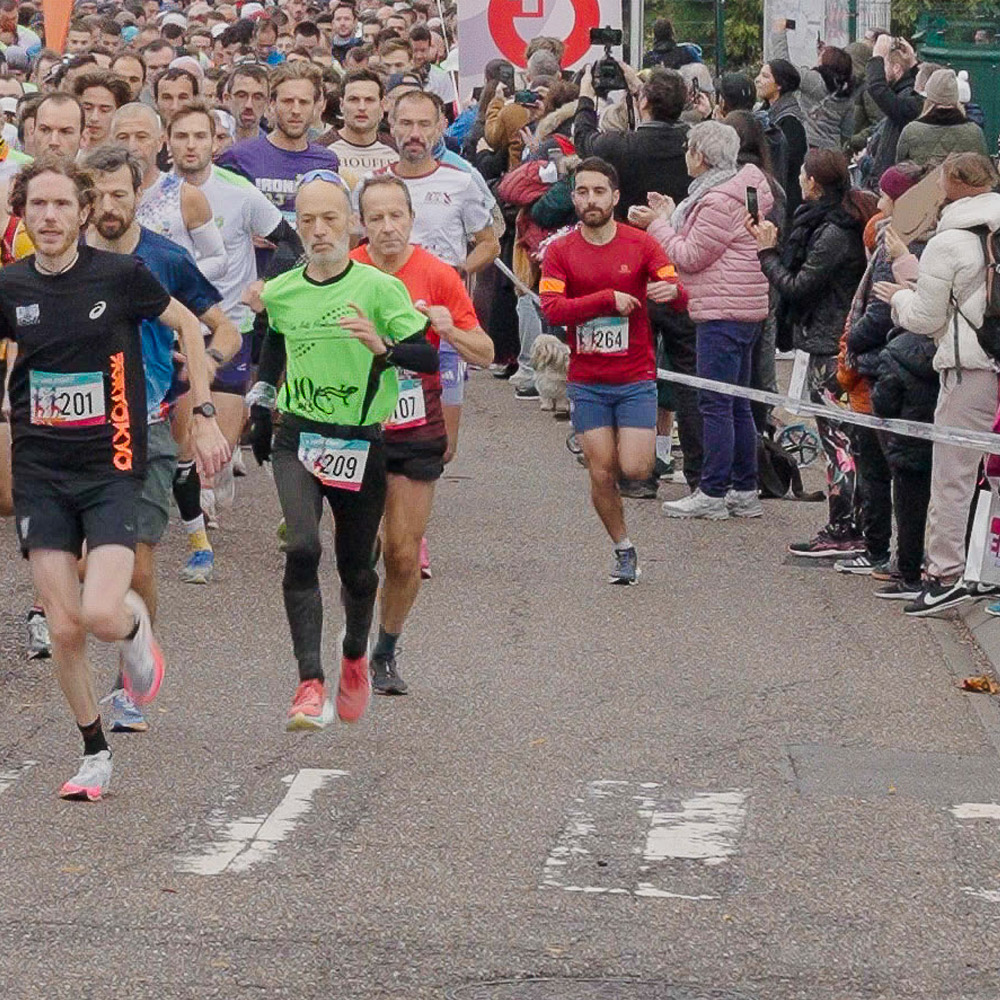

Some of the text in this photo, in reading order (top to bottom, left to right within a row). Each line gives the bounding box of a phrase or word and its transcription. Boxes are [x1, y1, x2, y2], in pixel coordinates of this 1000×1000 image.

[595, 331, 622, 348] 264
[61, 392, 93, 417] 201
[322, 453, 357, 480] 209
